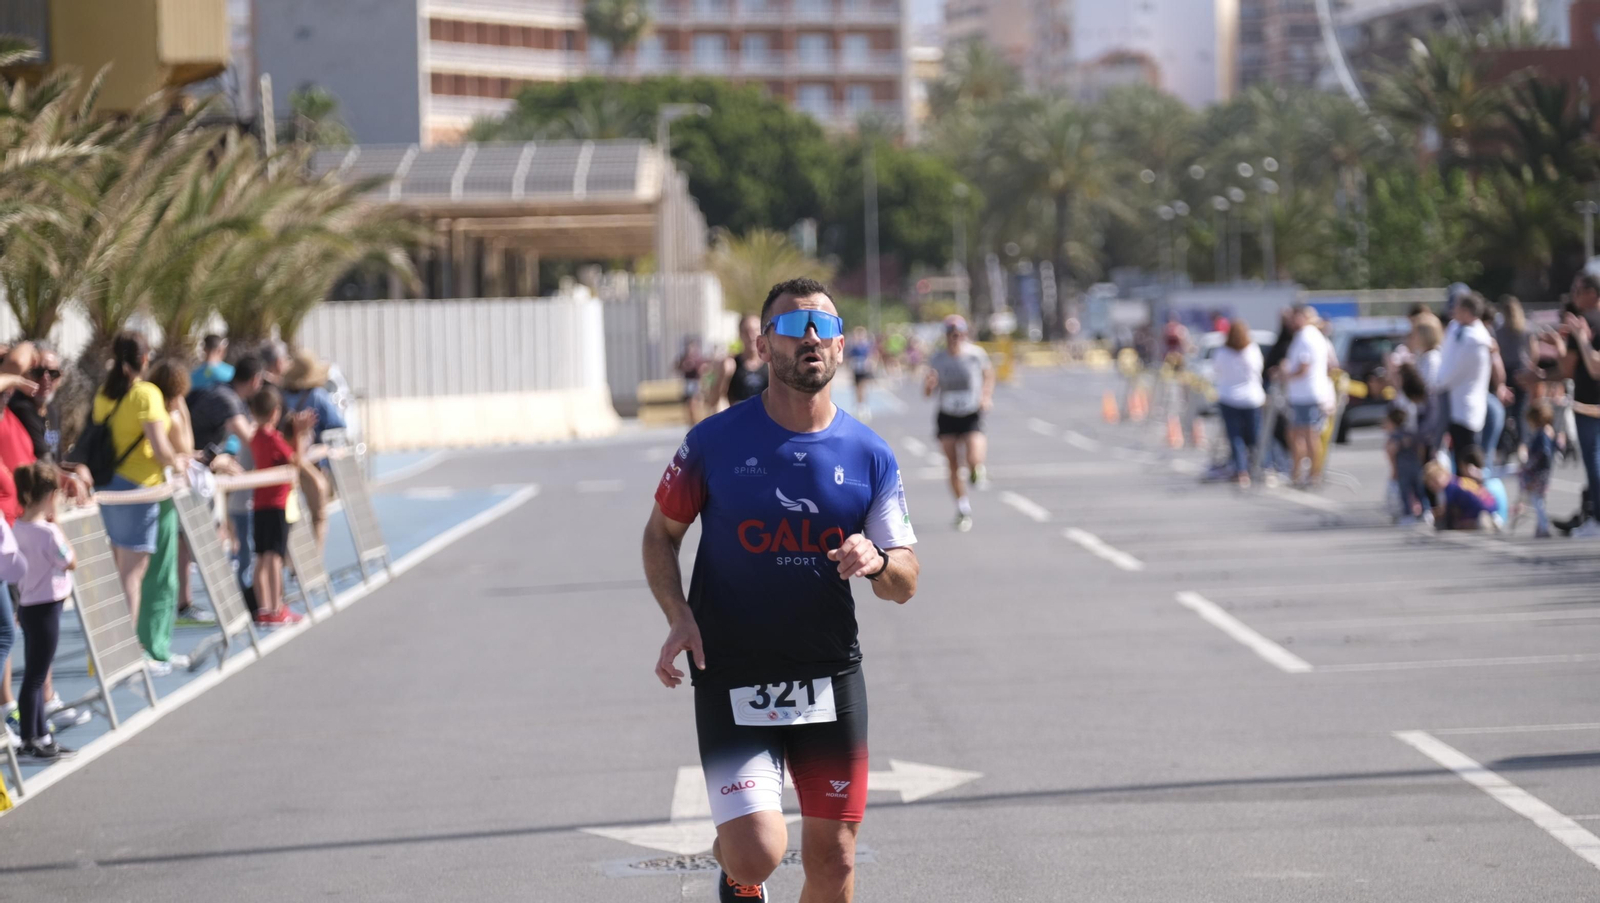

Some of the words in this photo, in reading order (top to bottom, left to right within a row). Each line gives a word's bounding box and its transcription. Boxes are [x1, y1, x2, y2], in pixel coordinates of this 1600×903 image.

[734, 466, 768, 475] SPIRAL
[737, 517, 845, 554] GALO
[776, 556, 816, 566] SPORT
[748, 680, 816, 710] 321
[720, 780, 756, 795] GALO
